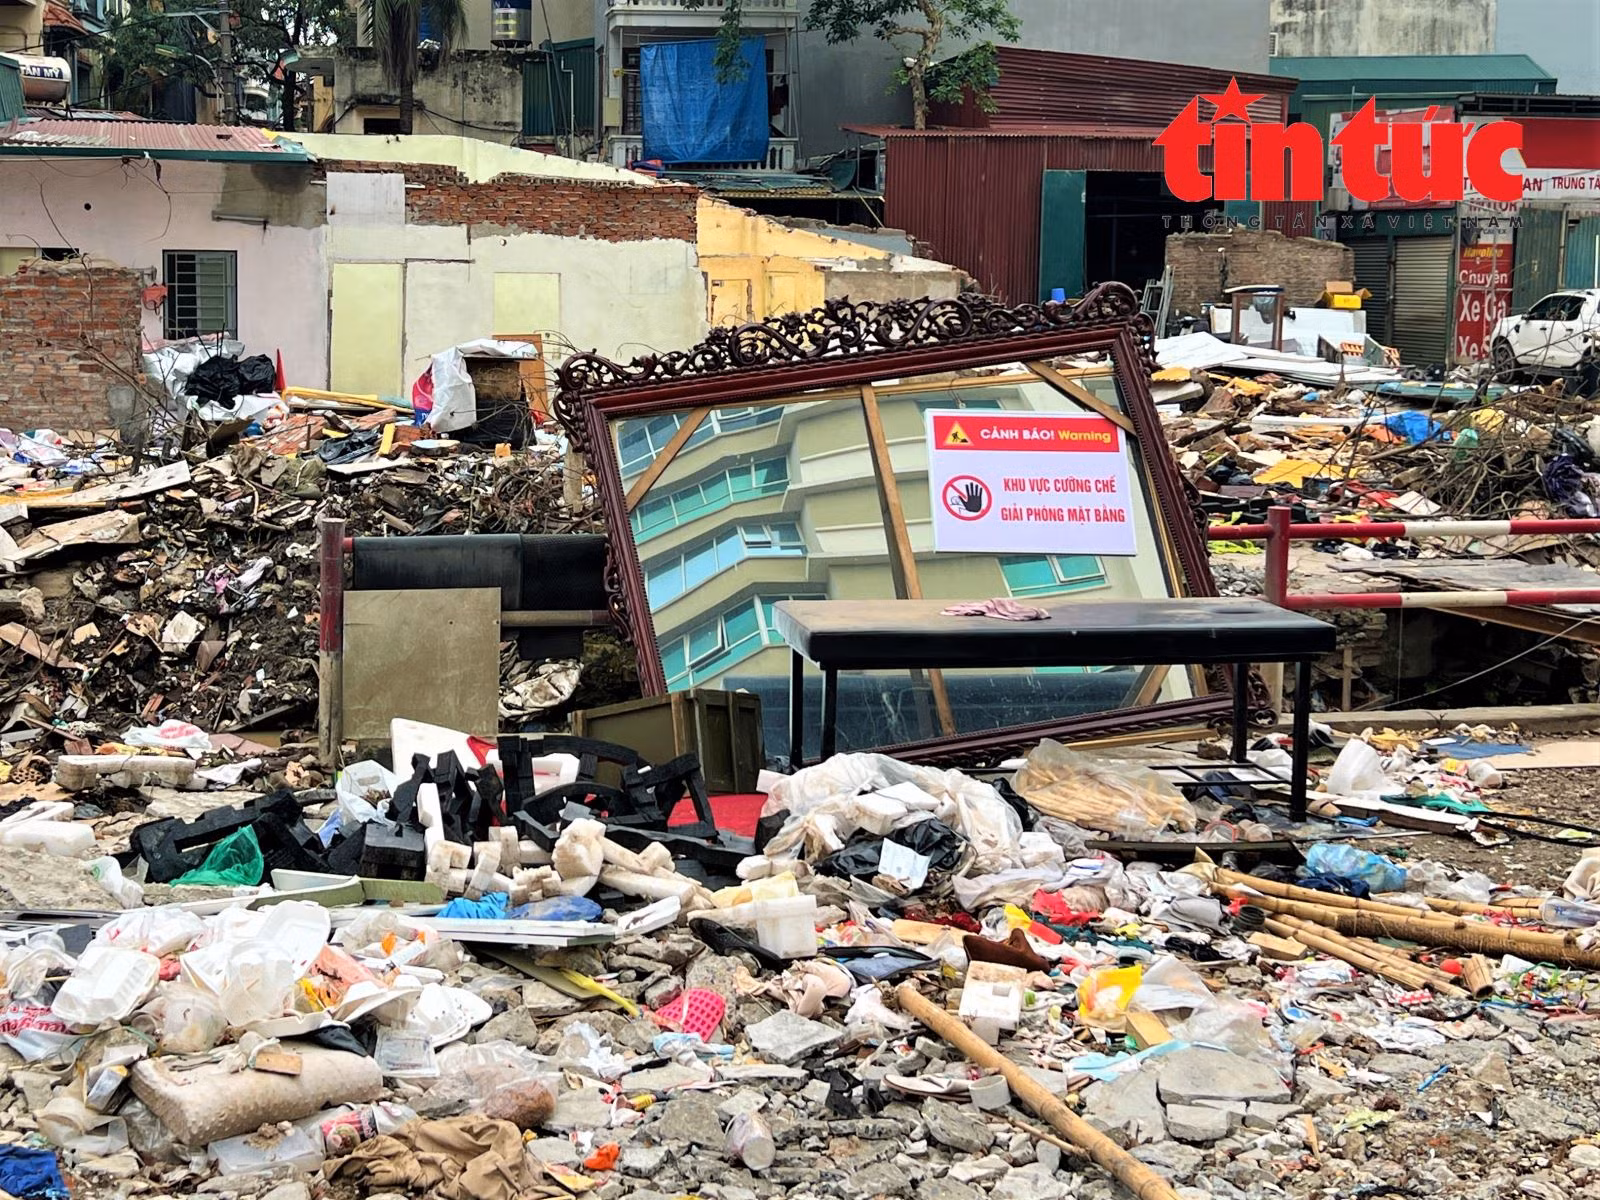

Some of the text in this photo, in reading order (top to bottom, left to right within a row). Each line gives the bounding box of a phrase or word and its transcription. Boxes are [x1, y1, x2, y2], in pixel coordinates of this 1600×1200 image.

[1552, 176, 1585, 190] TRUNG
[1460, 293, 1481, 322] Xe
[1459, 335, 1479, 360] Xe
[980, 426, 1111, 443] CẢNH BÁO! Warning
[1003, 478, 1026, 492] KHU
[1029, 477, 1050, 495] VỰC
[1095, 474, 1117, 493] CHẾ
[1001, 503, 1023, 521] GIẢI
